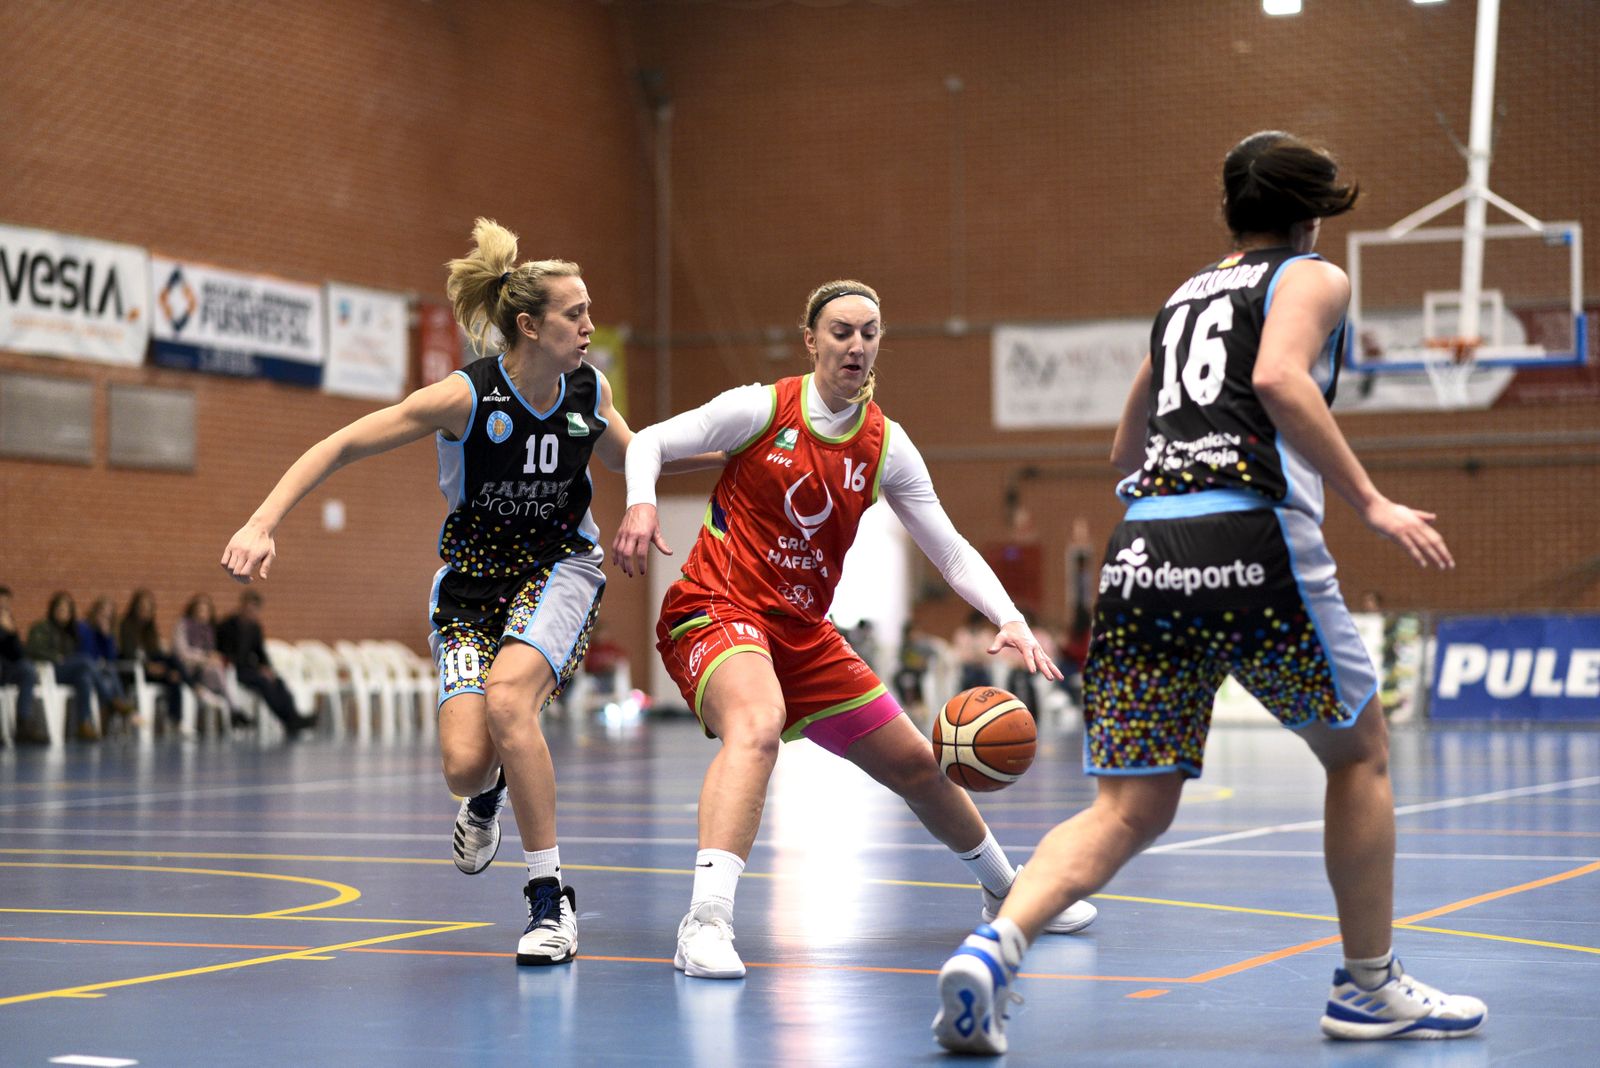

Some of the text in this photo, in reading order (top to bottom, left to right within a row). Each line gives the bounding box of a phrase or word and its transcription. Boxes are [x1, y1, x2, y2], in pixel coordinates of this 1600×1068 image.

[1157, 294, 1234, 416] 16
[523, 433, 559, 474] 10
[766, 453, 793, 468] vive
[843, 457, 868, 493] 16
[777, 535, 824, 562] GRUO
[445, 646, 480, 686] 10
